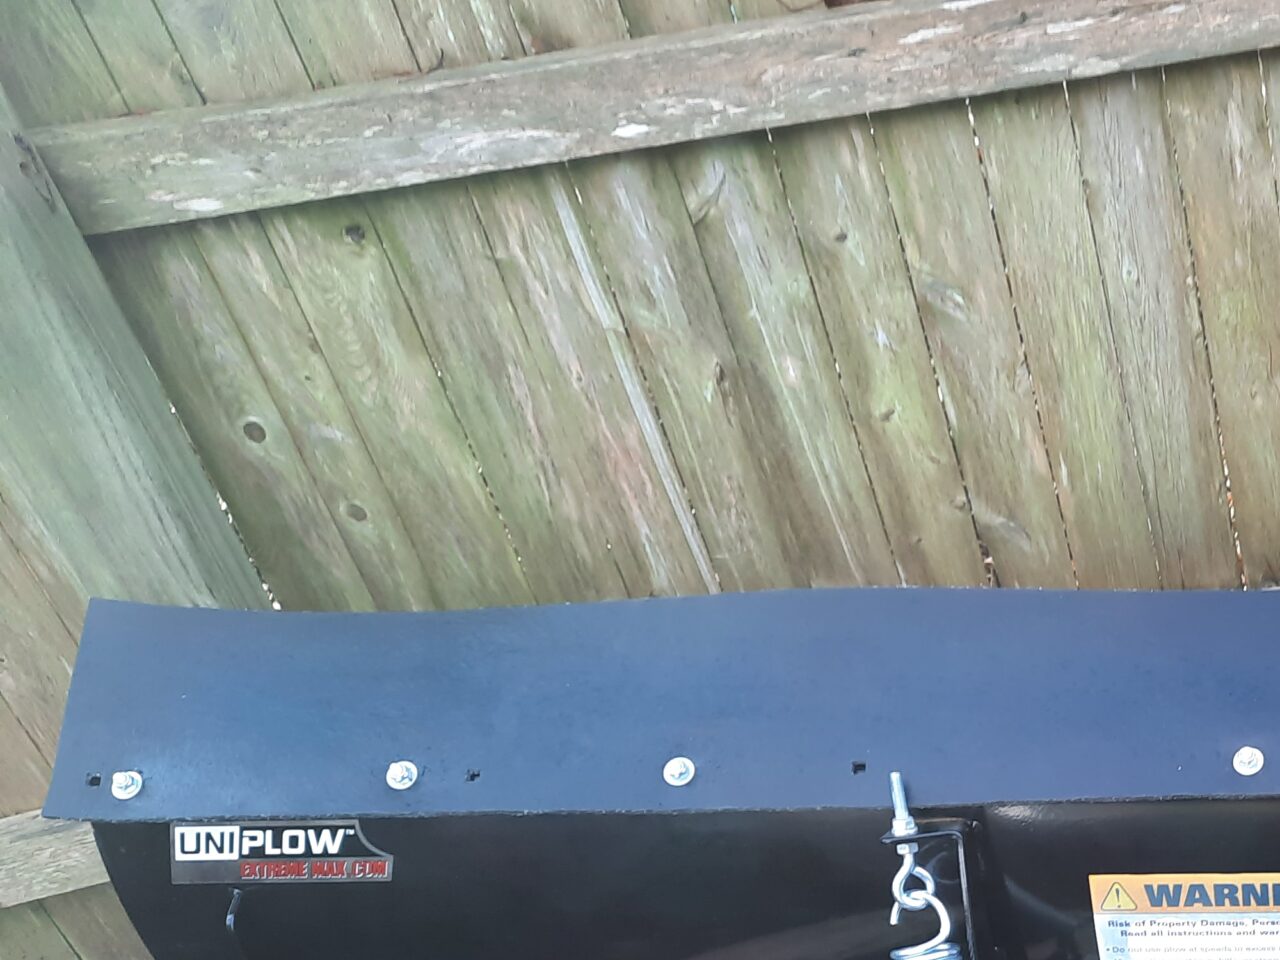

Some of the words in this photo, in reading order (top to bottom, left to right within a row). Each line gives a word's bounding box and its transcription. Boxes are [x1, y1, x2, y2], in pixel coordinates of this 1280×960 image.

[240, 861, 309, 879] EXTREME
[1108, 920, 1131, 928] Risk
[1150, 920, 1197, 928] Property
[1200, 918, 1248, 928] Damage,
[1120, 930, 1147, 938] Read
[1112, 946, 1126, 954] Do
